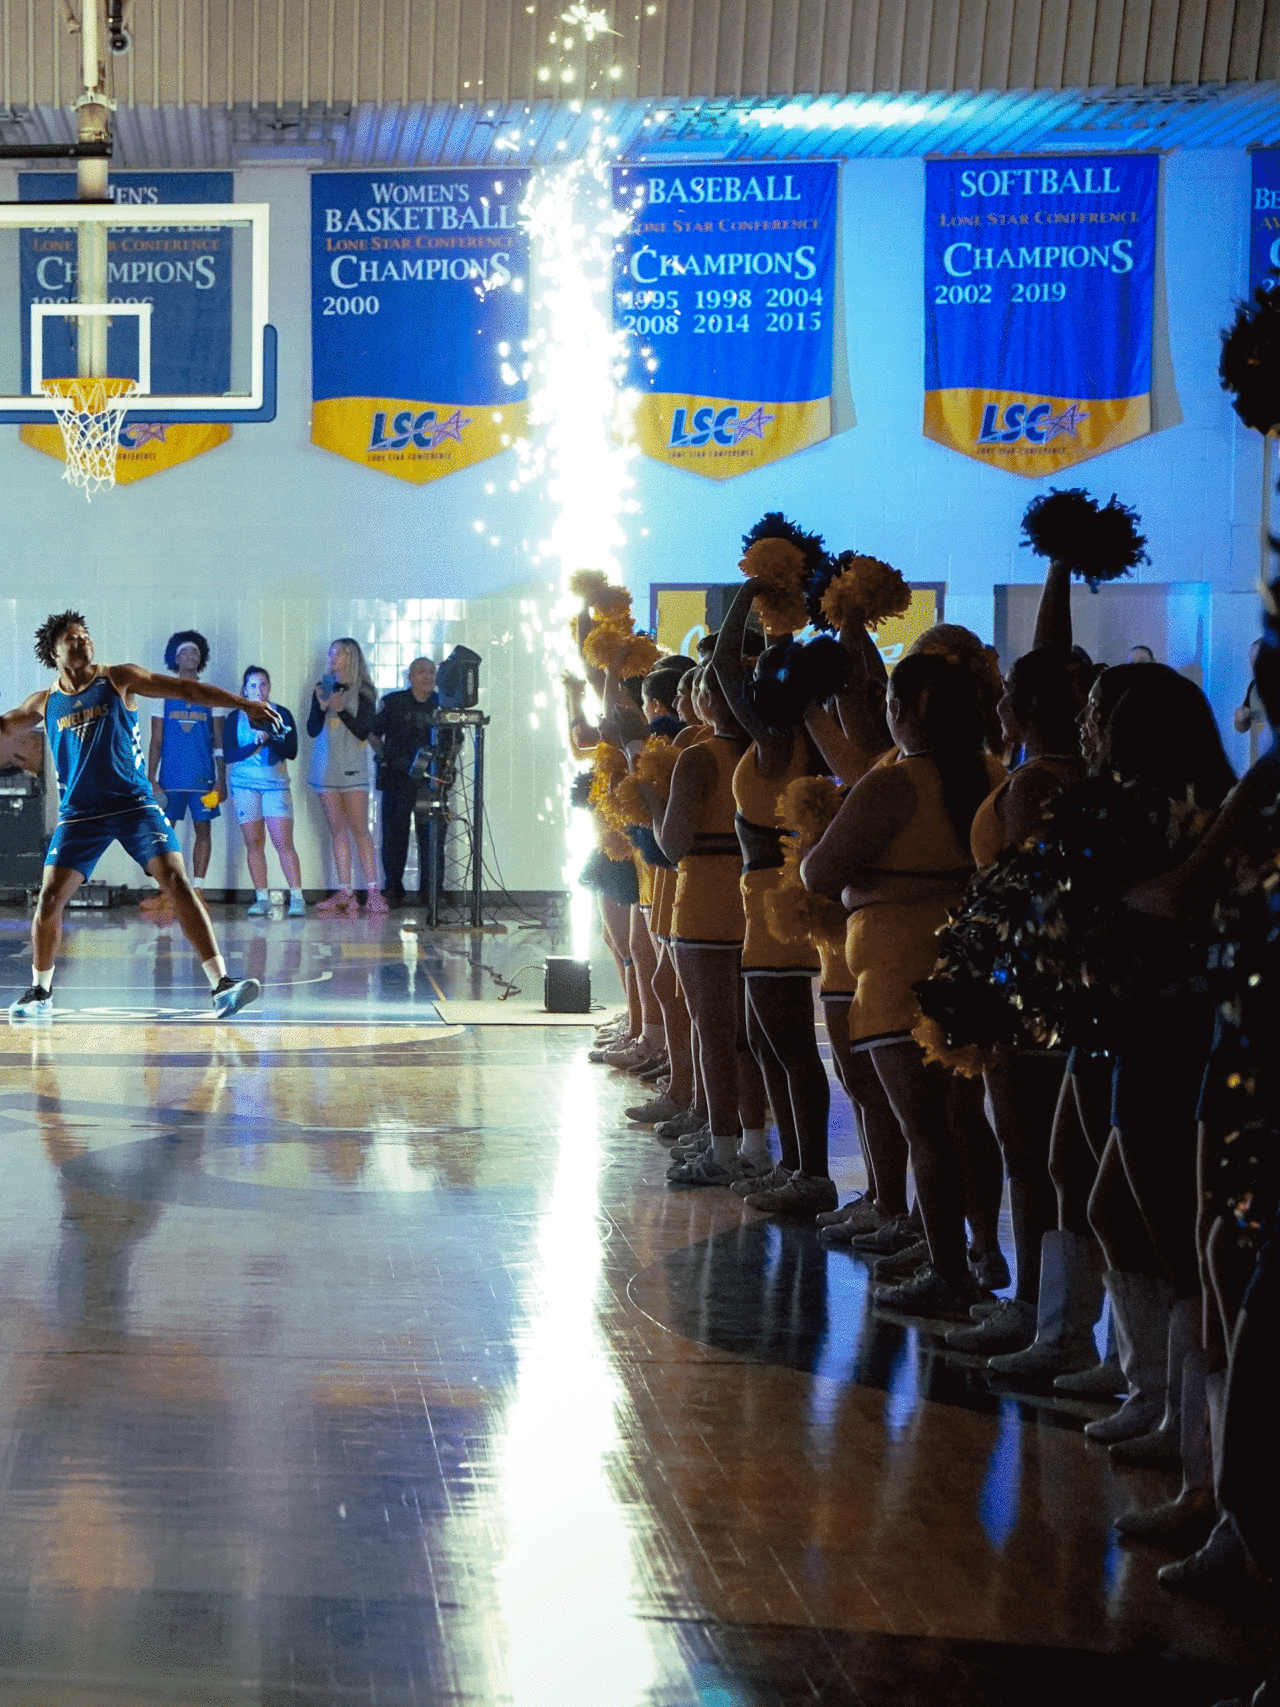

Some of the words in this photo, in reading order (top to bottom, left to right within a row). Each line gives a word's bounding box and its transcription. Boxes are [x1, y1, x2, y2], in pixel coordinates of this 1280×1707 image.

[371, 182, 470, 204] WOMEN'S
[648, 175, 801, 204] BASEBALL
[960, 167, 1120, 197] SOFTBALL
[324, 205, 516, 232] BASKETBALL
[672, 219, 714, 233] STAR
[718, 218, 819, 232] CONFERENCE
[939, 213, 981, 228] LONE
[987, 212, 1029, 226] STAR
[1034, 211, 1137, 226] CONFERENCE
[33, 239, 74, 253] LONE
[122, 237, 219, 252] CONFERENCE
[326, 237, 367, 252] LONE
[371, 236, 410, 251] STAR
[330, 252, 512, 289] CHAMPIONS
[630, 246, 817, 284] CHAMPIONS
[943, 239, 1134, 277] CHAMPIONS
[37, 255, 216, 290] CHMPIONS
[322, 296, 380, 316] 2000
[623, 290, 679, 310] 1995
[695, 288, 752, 310] 1998
[765, 287, 823, 308] 2004
[935, 284, 992, 305] 2002
[1011, 281, 1067, 303] 2019
[623, 314, 679, 335] 2008
[693, 313, 750, 334] 2014
[765, 311, 822, 332] 2015
[367, 410, 437, 451] LSC
[666, 405, 739, 449] LSC
[977, 403, 1051, 444] LSC
